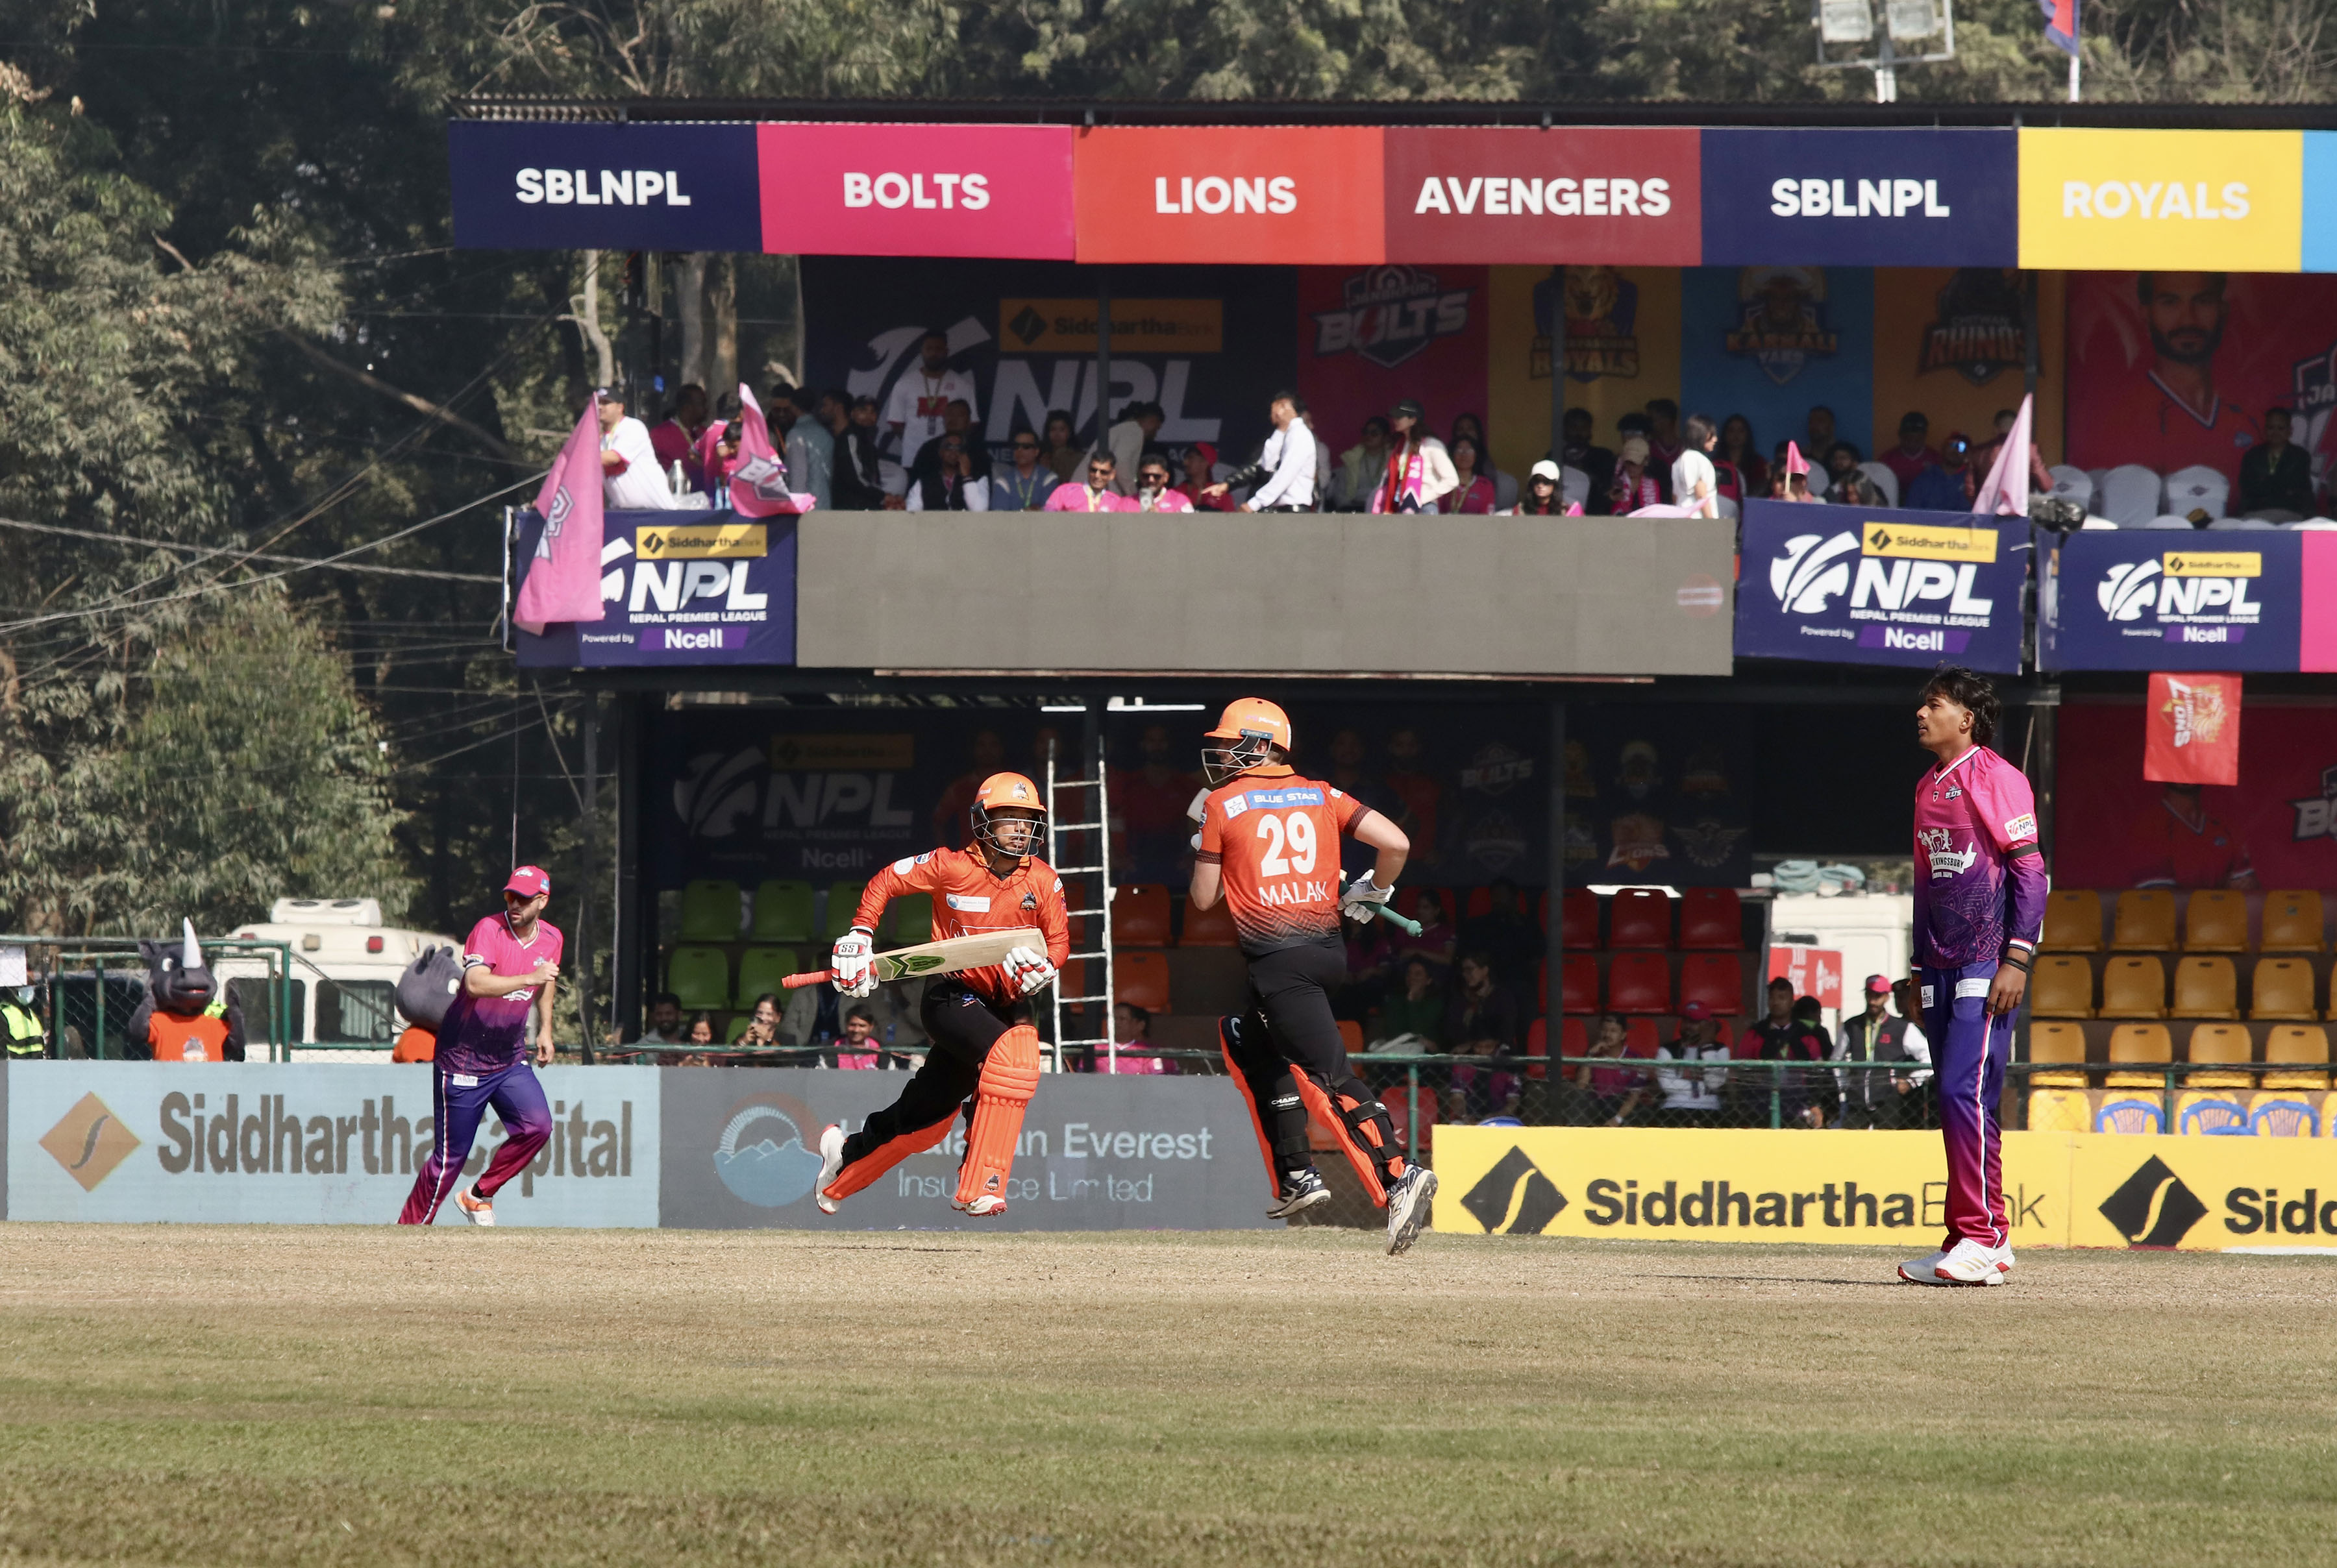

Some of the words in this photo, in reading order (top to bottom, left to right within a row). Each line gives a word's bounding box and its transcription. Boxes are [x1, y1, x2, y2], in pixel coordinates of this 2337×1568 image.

[515, 168, 691, 207] SBLNPL
[843, 172, 990, 210] BOLTS
[1155, 176, 1297, 215] LIONS
[1415, 177, 1671, 217] AVENGERS
[1770, 178, 1950, 218] SBLNPL
[2062, 180, 2251, 220] ROYALS
[1314, 293, 1468, 353] BOLTS
[984, 358, 1223, 443] NPL
[628, 560, 768, 612] NPL
[1849, 557, 1994, 616] NPL
[2157, 577, 2262, 615] NPL
[629, 613, 667, 624] NEPAL
[668, 612, 719, 623] PREMIER
[721, 611, 767, 622] LEAGUE
[1801, 625, 1838, 637] Powered
[1840, 628, 1855, 640] by
[1850, 609, 1888, 622] NEPAL
[1890, 611, 1942, 625] PREMIER
[1943, 615, 1990, 628] LEAGUE
[2183, 626, 2227, 643] Ncell
[582, 633, 621, 643] Powered
[622, 633, 635, 644] by
[665, 628, 723, 649] Ncell
[1885, 626, 1944, 652] Ncell
[762, 773, 914, 827] NPL
[1254, 794, 1283, 803] BLUE
[1287, 792, 1318, 802] STAR
[2019, 820, 2034, 831] NPL
[801, 847, 865, 868] Ncell
[1257, 812, 1317, 877] 29
[1258, 881, 1329, 907] MALAN
[841, 944, 854, 953] SS
[1064, 1123, 1213, 1160] Everest
[898, 1168, 1039, 1201] Insuce
[1050, 1171, 1154, 1202] Lmted
